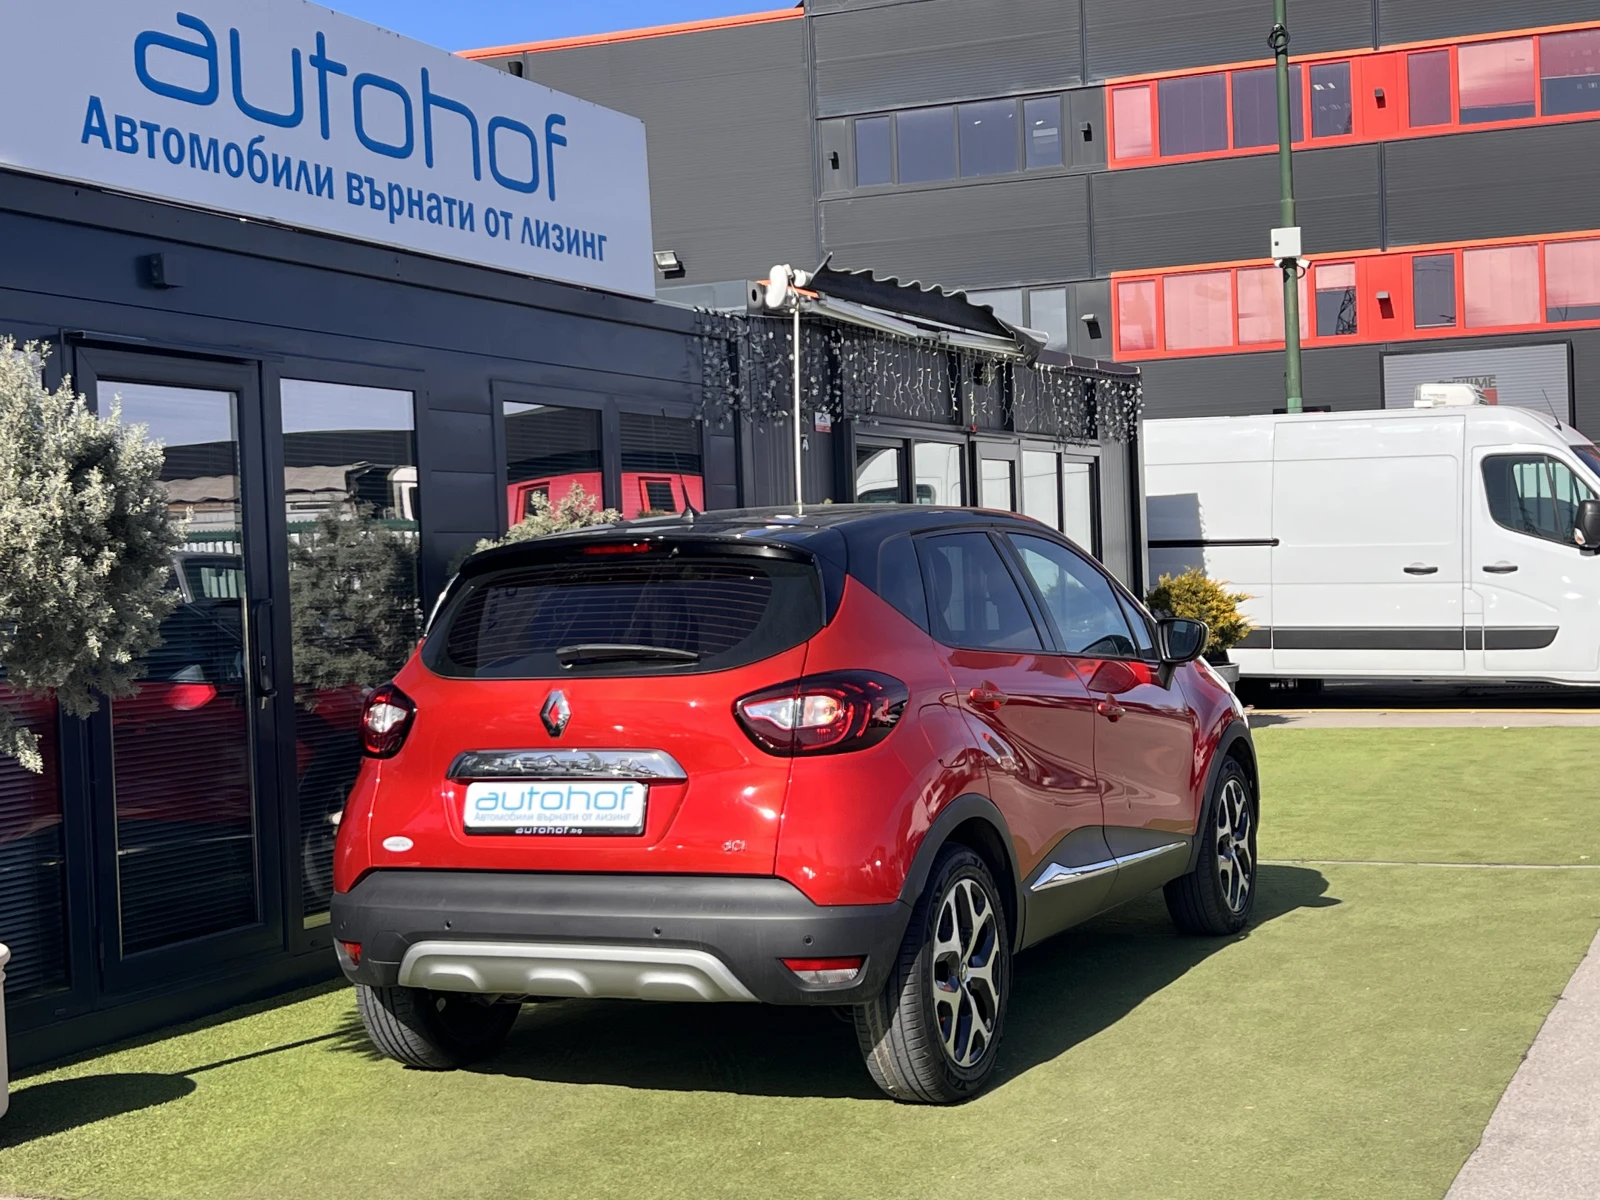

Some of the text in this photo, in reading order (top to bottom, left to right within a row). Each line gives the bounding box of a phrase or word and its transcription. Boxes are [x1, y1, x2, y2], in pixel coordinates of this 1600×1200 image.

[134, 12, 567, 201] autohof
[81, 95, 607, 261] Автомобили върнати от лизинг
[474, 812, 631, 823] Автомобили върнати от лизинг
[475, 785, 634, 811] autohof
